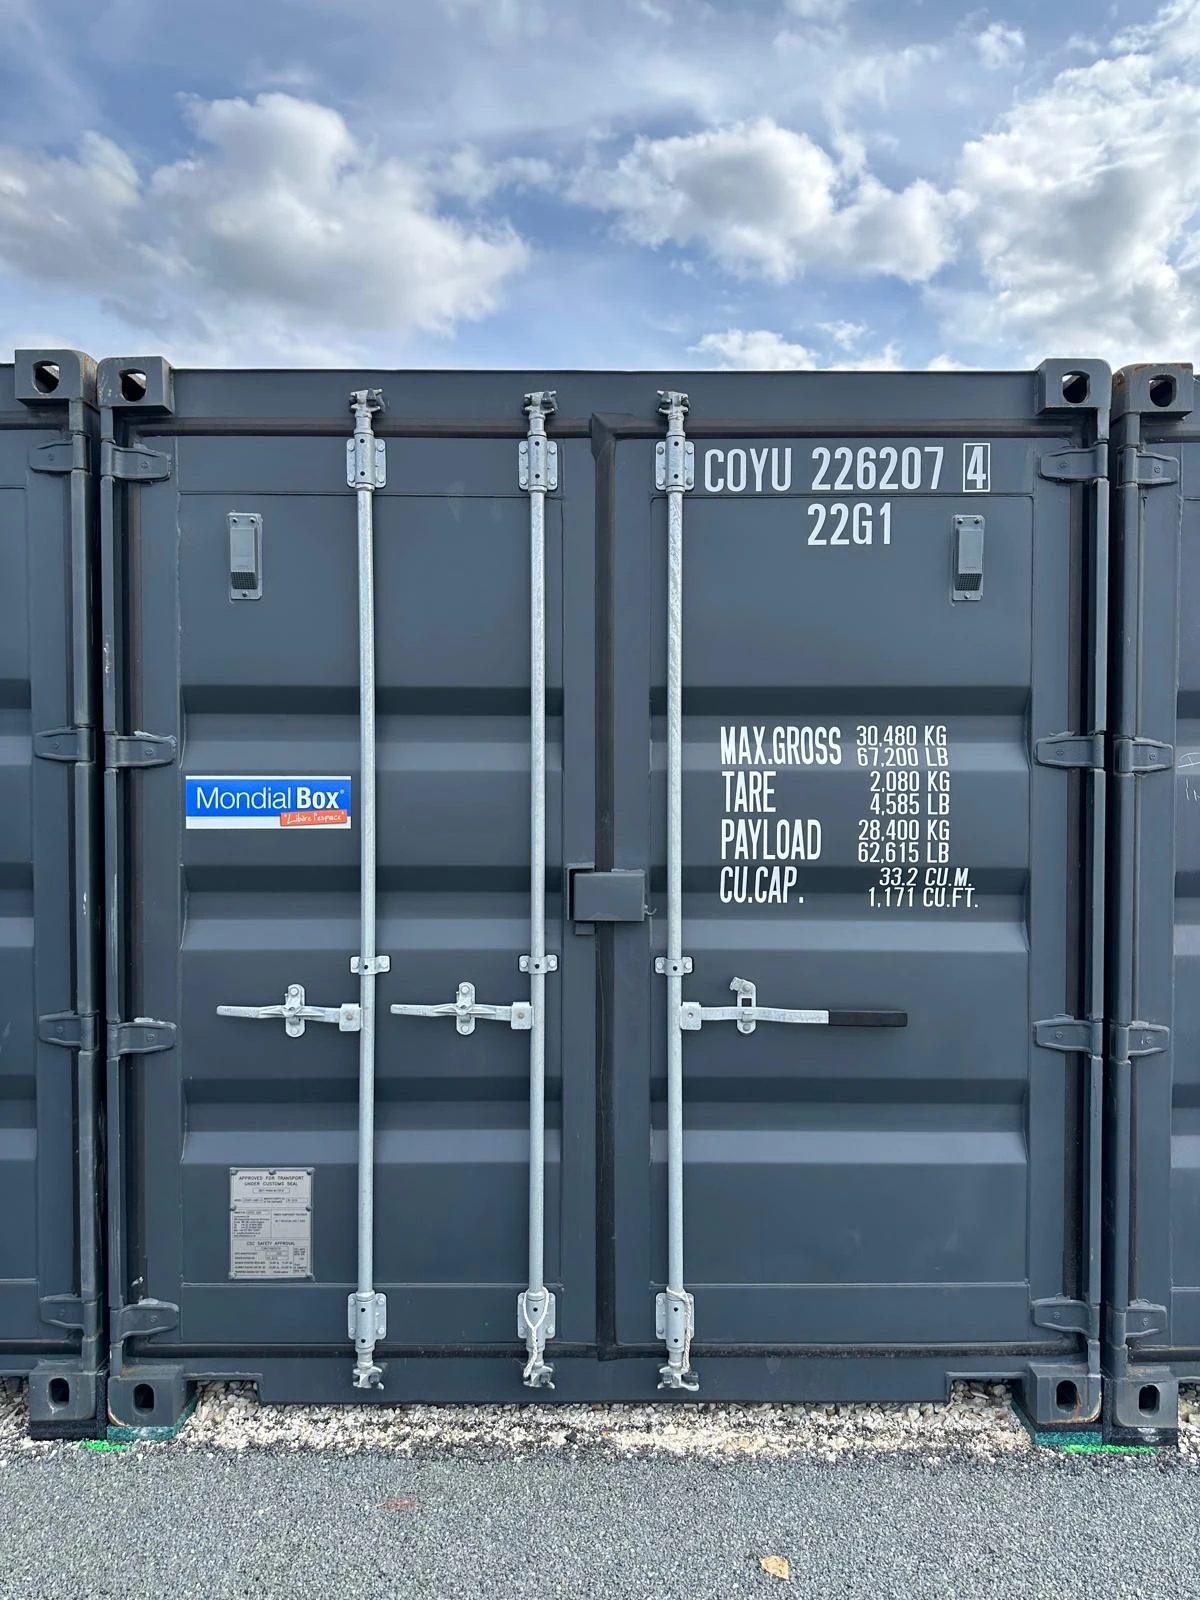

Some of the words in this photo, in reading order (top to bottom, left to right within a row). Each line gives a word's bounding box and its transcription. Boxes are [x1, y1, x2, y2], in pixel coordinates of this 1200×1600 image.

[704, 447, 792, 492] COYU
[811, 446, 944, 491] 226207
[807, 502, 891, 546] 22G1
[720, 726, 842, 765] MAX.GROSS
[856, 725, 917, 747] 30,480
[924, 726, 947, 746] KG
[857, 747, 919, 768] 67,200
[926, 748, 949, 767] LB
[196, 786, 291, 809] Mondial
[721, 771, 777, 813] TARE
[870, 771, 920, 793] 2,080
[927, 771, 951, 792] KG
[870, 793, 920, 815] 4,585
[927, 794, 950, 815] LB
[721, 819, 822, 860] PAYLOAD
[858, 819, 920, 841] 28,400
[927, 819, 950, 841] KG
[858, 842, 919, 864] 62,615
[926, 843, 949, 863] LB
[879, 867, 918, 887] 33.2
[924, 867, 973, 887] CU.M.
[868, 887, 915, 908] 1,171
[922, 887, 980, 908] CU.FT.
